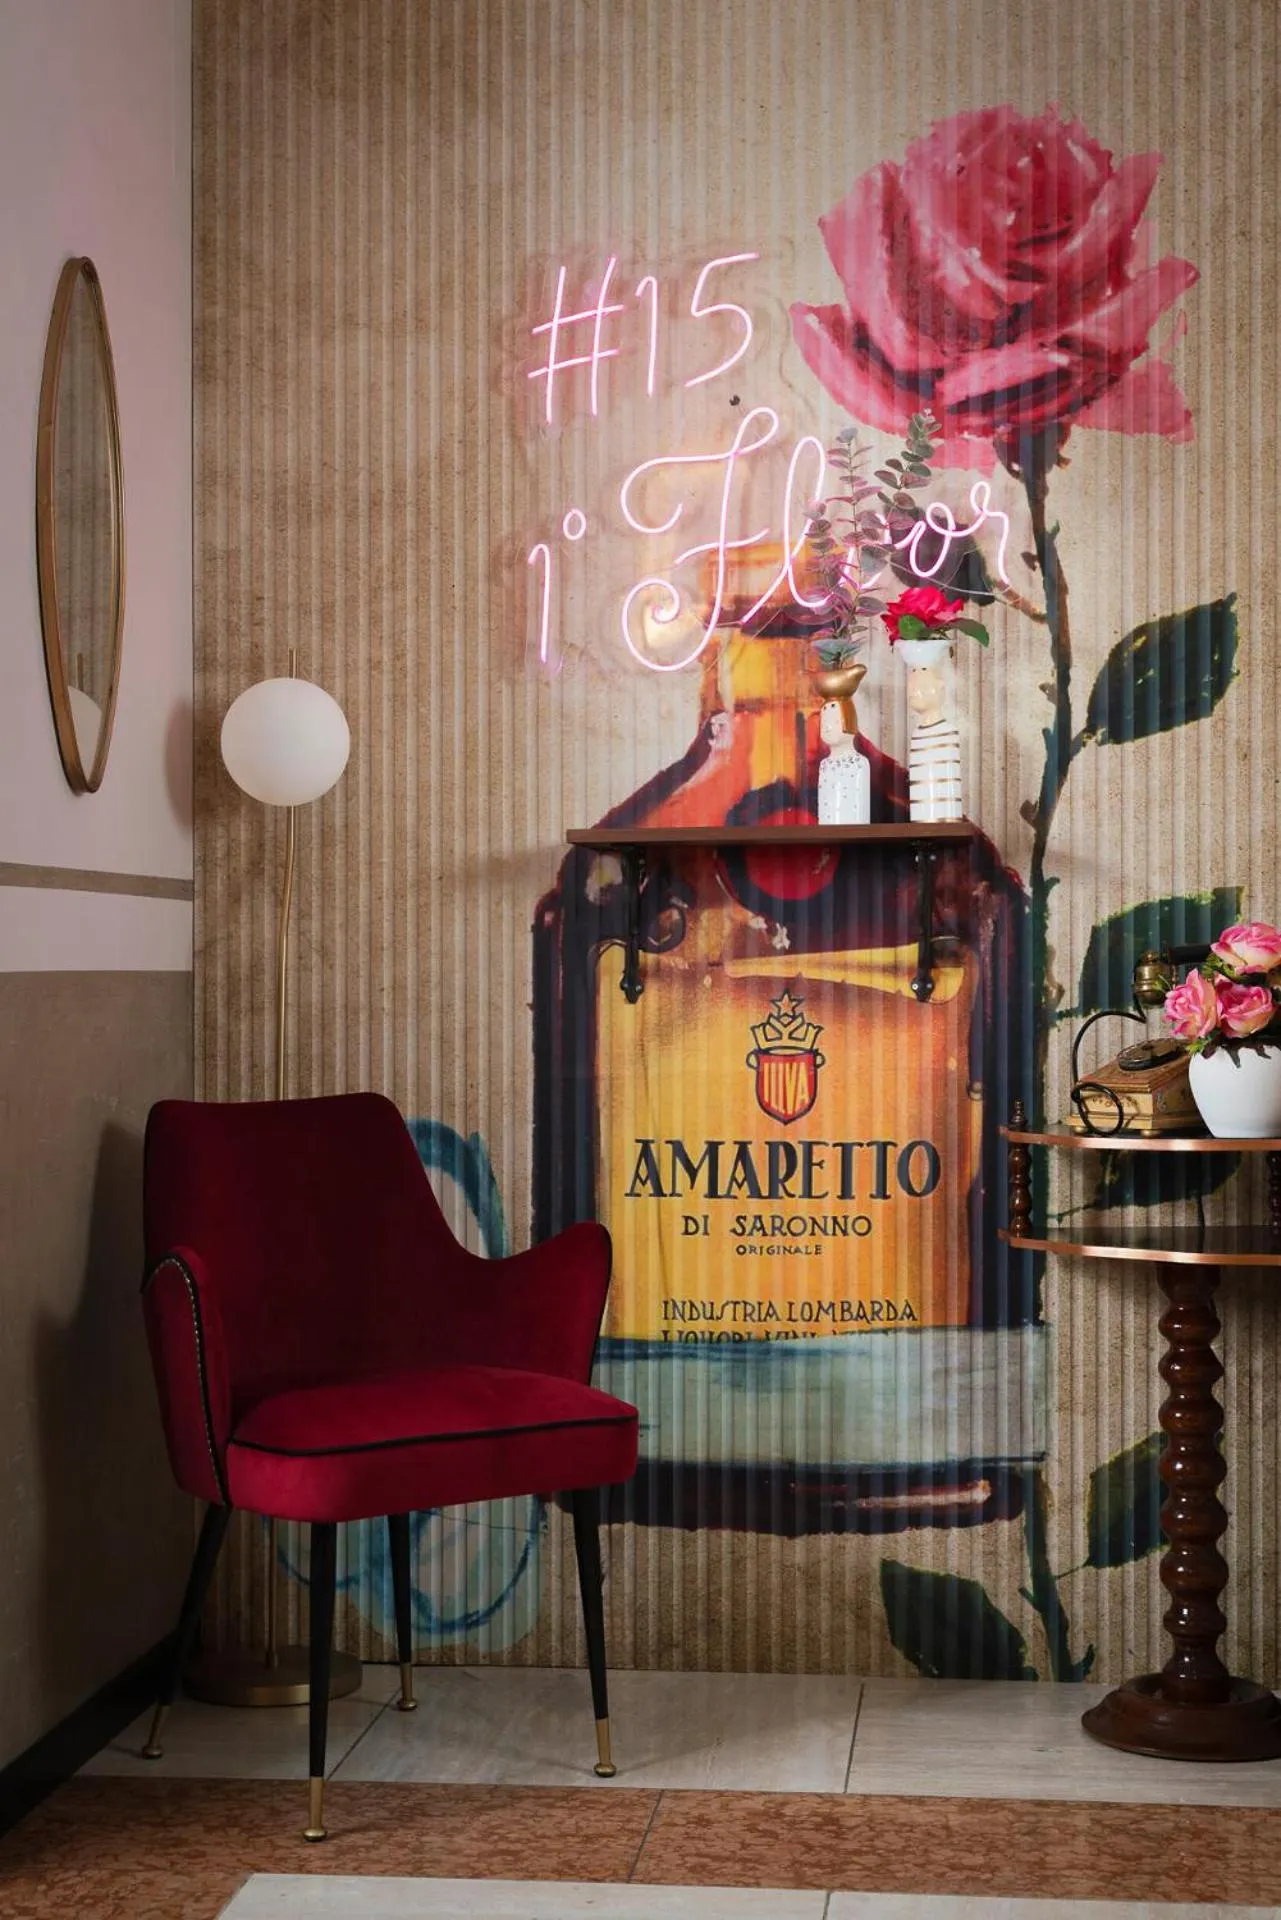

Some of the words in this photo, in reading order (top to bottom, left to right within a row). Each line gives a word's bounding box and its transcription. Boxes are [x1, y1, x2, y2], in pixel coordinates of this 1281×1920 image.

[528, 252, 760, 425] #15
[624, 1138, 941, 1200] AMARETTO
[681, 1214, 710, 1237] DI
[729, 1214, 873, 1237] SARONNO
[735, 1243, 823, 1256] ORIGINALE
[662, 1298, 781, 1323] INDUSTRIA
[786, 1298, 918, 1325] LOMBARDA
